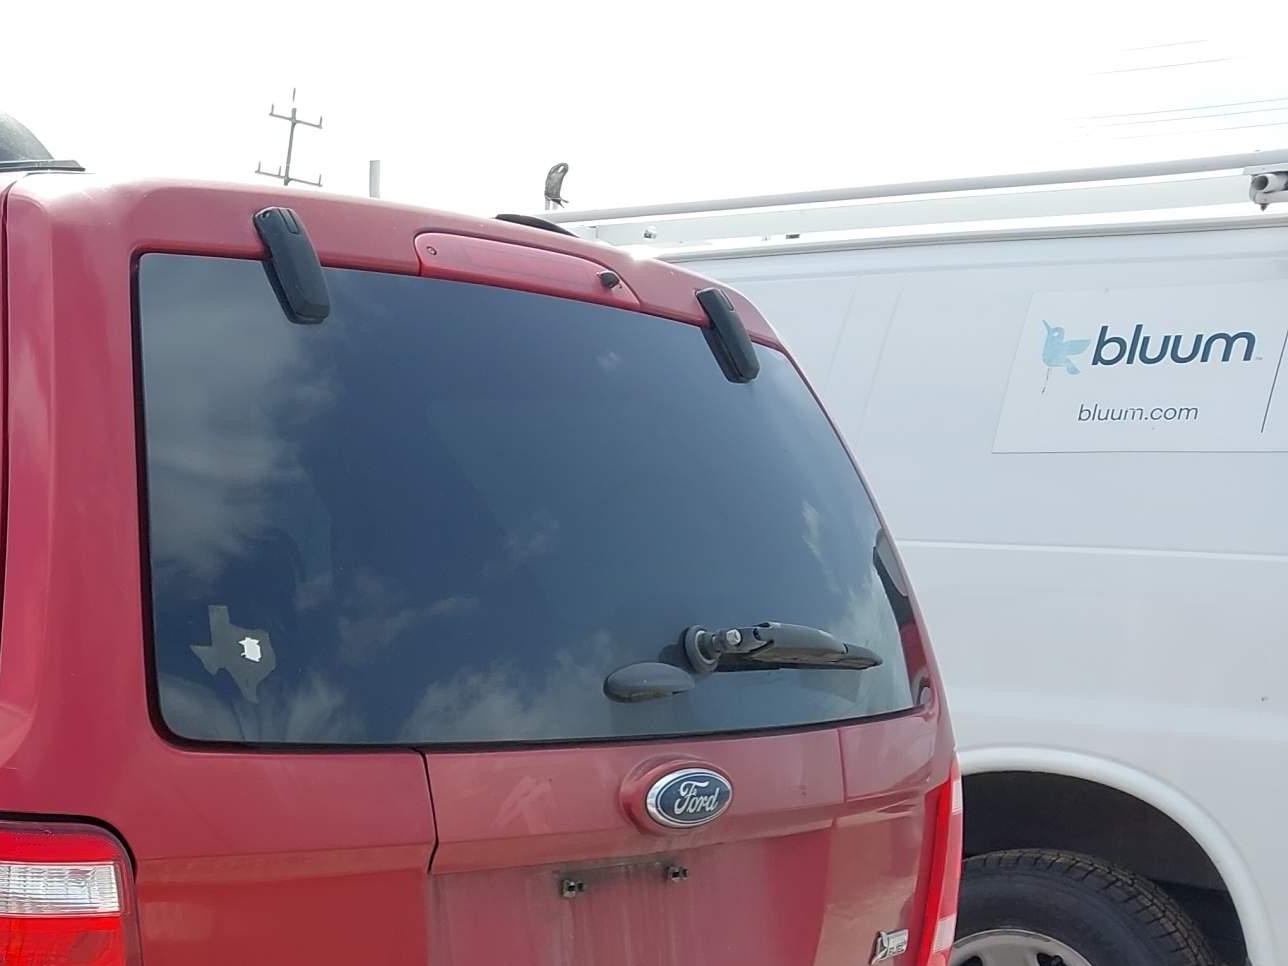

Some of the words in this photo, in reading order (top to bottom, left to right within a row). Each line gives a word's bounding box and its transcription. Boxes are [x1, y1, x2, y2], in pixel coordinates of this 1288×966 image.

[1091, 324, 1257, 366] bluum
[1077, 404, 1199, 422] bluum.com
[674, 780, 720, 815] Ford
